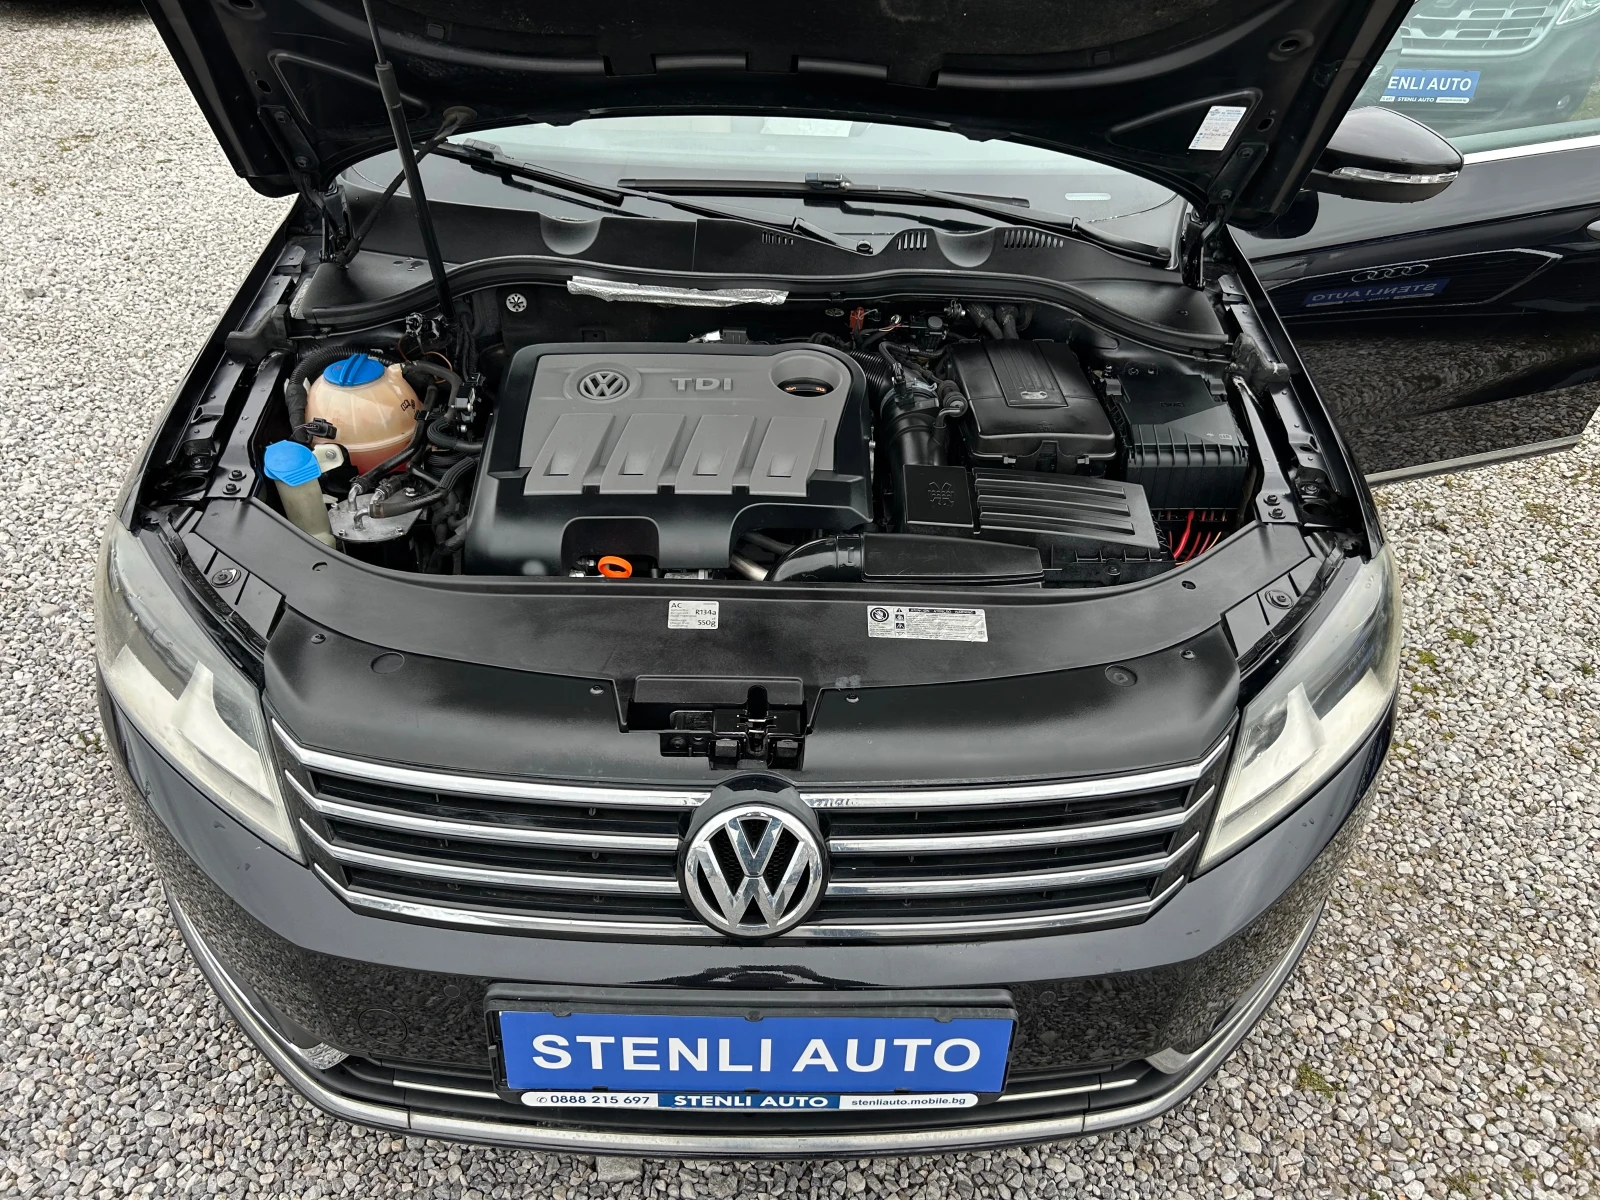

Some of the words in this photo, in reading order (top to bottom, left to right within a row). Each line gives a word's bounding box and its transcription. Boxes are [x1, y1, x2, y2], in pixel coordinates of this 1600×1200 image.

[1426, 77, 1472, 91] AUTO
[671, 377, 732, 391] TDI
[697, 619, 716, 628] 550g
[531, 1034, 772, 1073] STENLI
[792, 1037, 982, 1074] AUTO
[550, 1095, 587, 1104] 0888
[591, 1096, 619, 1105] 215
[623, 1096, 650, 1105] 697
[673, 1095, 752, 1107] STENLI
[759, 1096, 829, 1108] AUTO
[851, 1097, 967, 1106] stenliauto.mobile.bg
